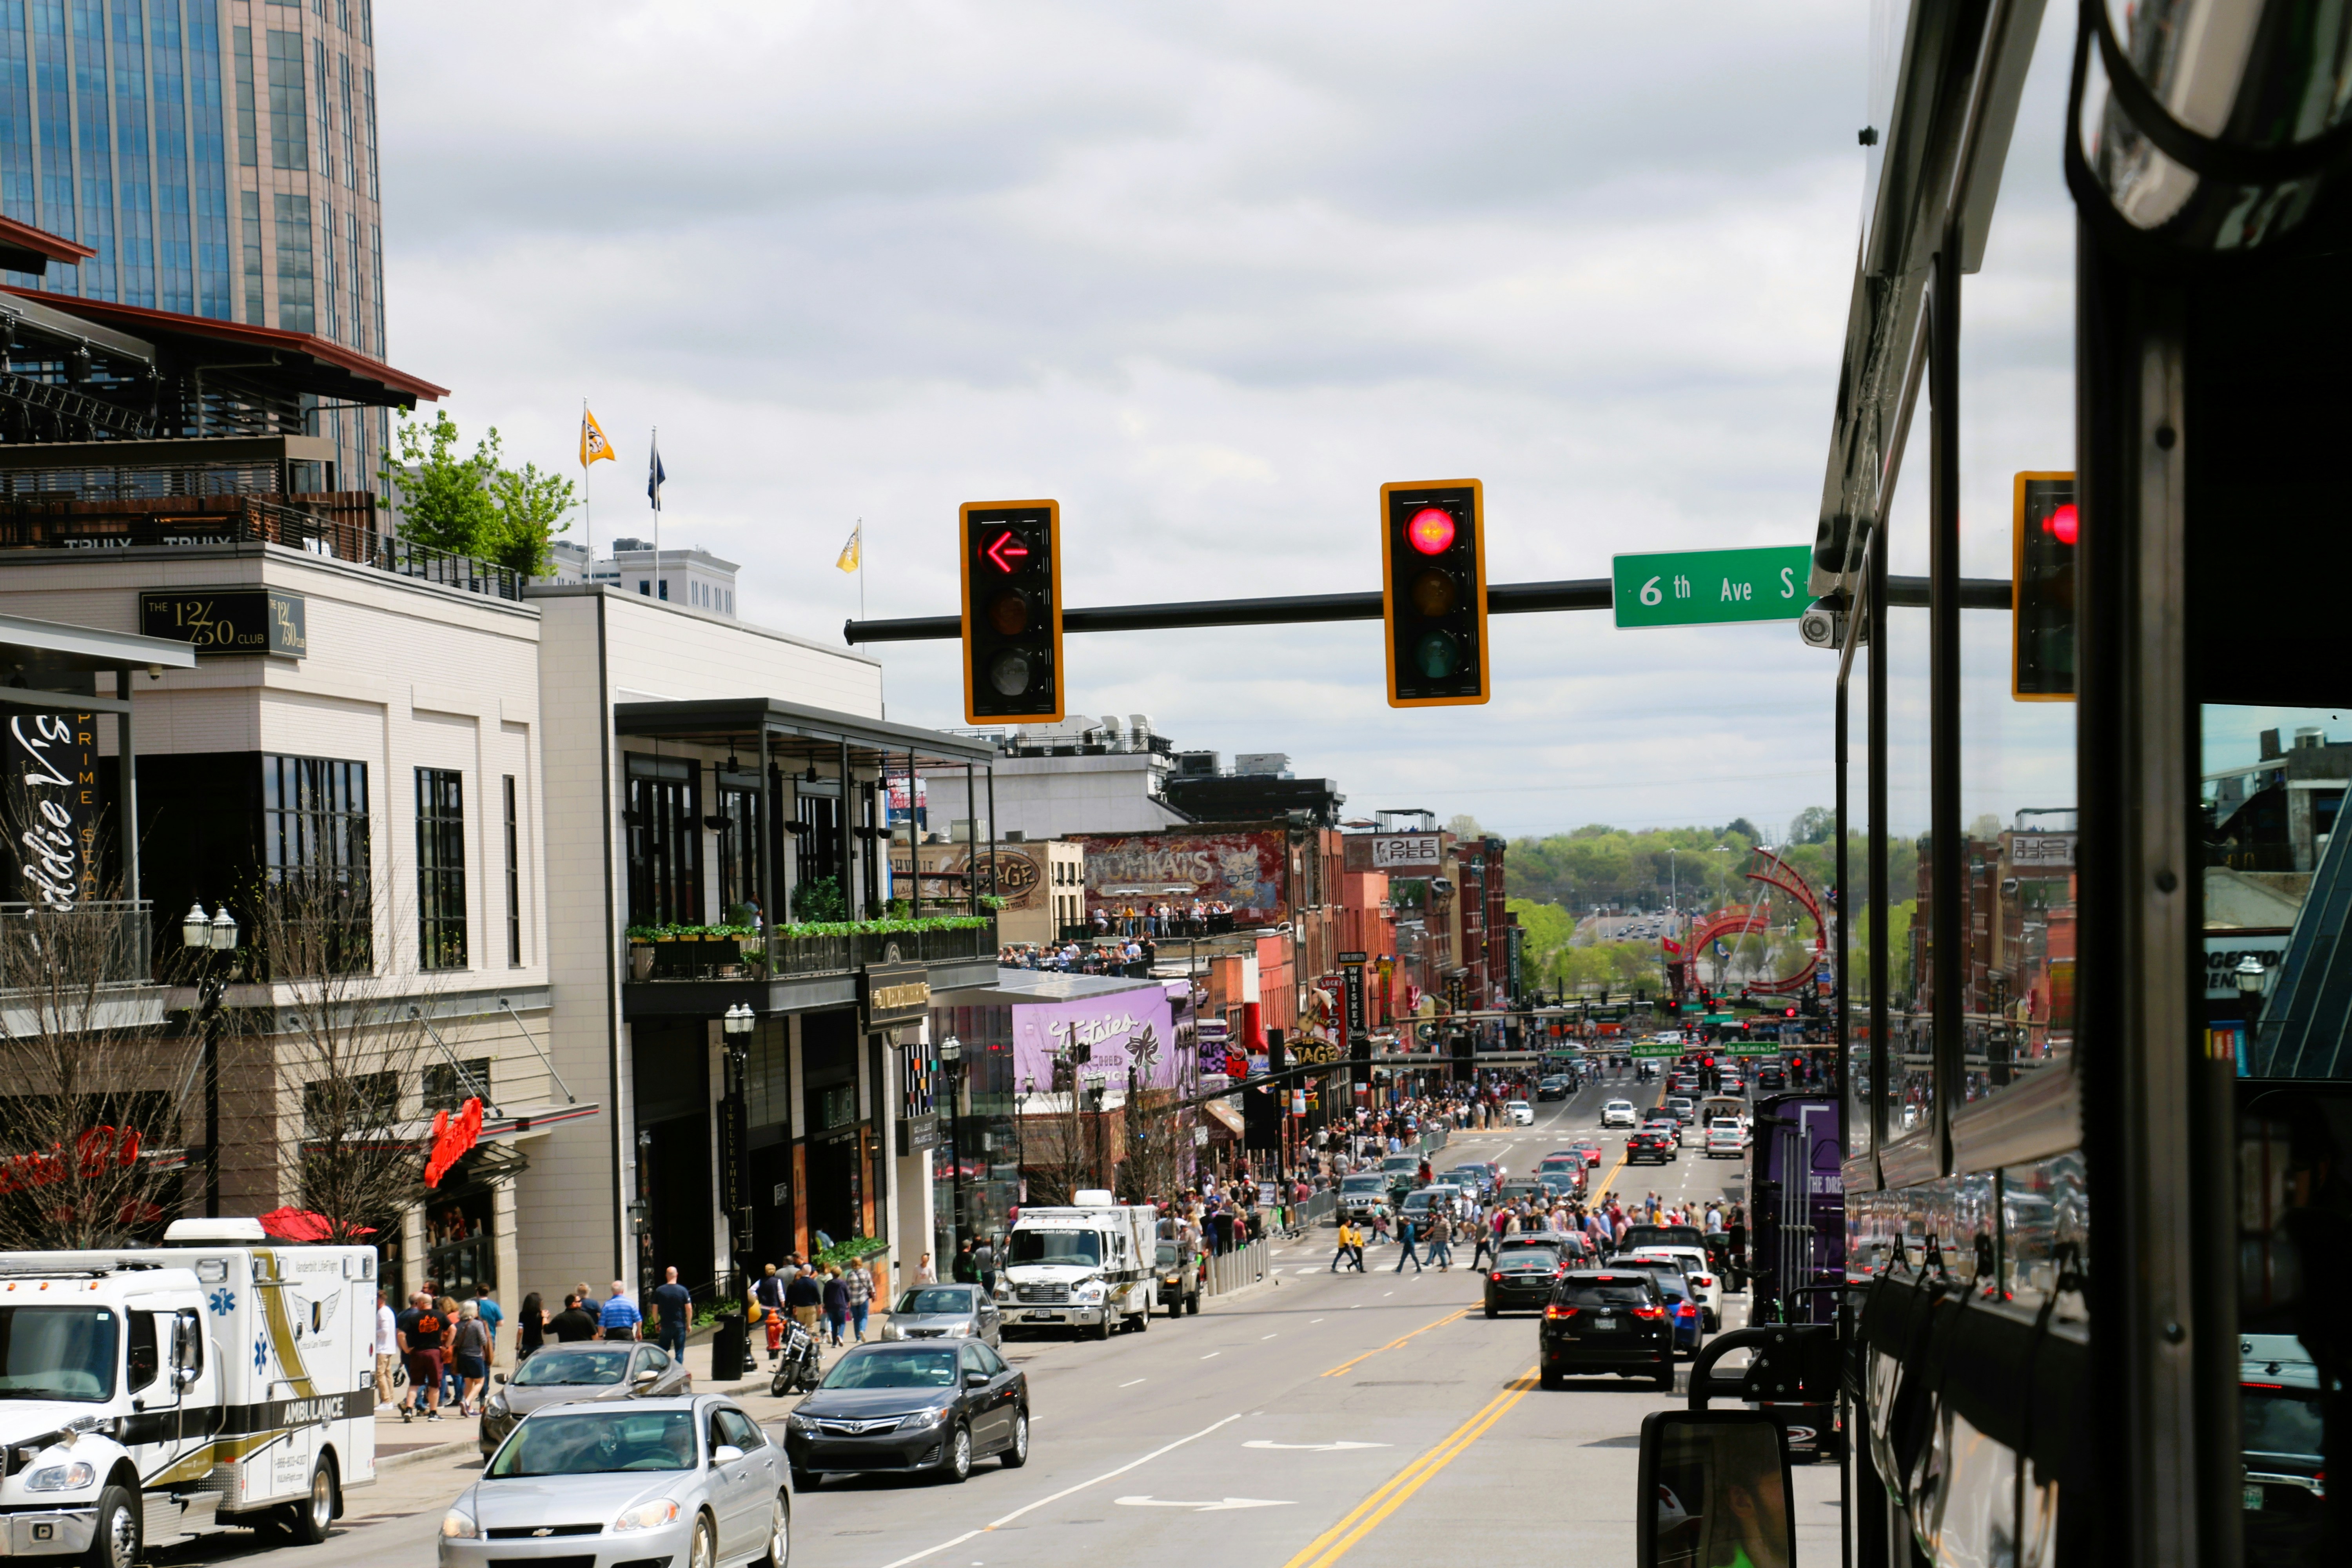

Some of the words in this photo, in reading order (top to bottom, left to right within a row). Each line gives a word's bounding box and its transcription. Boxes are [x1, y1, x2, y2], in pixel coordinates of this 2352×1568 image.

[1640, 575, 1662, 606] 6
[1673, 574, 1691, 599] th
[1720, 577, 1752, 602] Ave
[1780, 567, 1795, 599] S
[149, 603, 168, 612] THE
[238, 634, 264, 644] CLUB
[1390, 840, 1435, 850] OLE
[1390, 849, 1436, 859] RED
[1348, 966, 1358, 1027] WHISKEY
[1049, 1013, 1140, 1046] Totsies
[1659, 1045, 1671, 1054] Lewis
[1747, 1044, 1760, 1052] Lewis
[1085, 1055, 1123, 1068] CHID
[727, 1104, 735, 1156] TWELVE
[729, 1161, 737, 1212] THIRTY
[1825, 1176, 1843, 1193] DRE
[296, 1260, 317, 1273] Vanderbilt
[318, 1259, 338, 1274] LifeFlight
[283, 1397, 343, 1425] AMBULANCE
